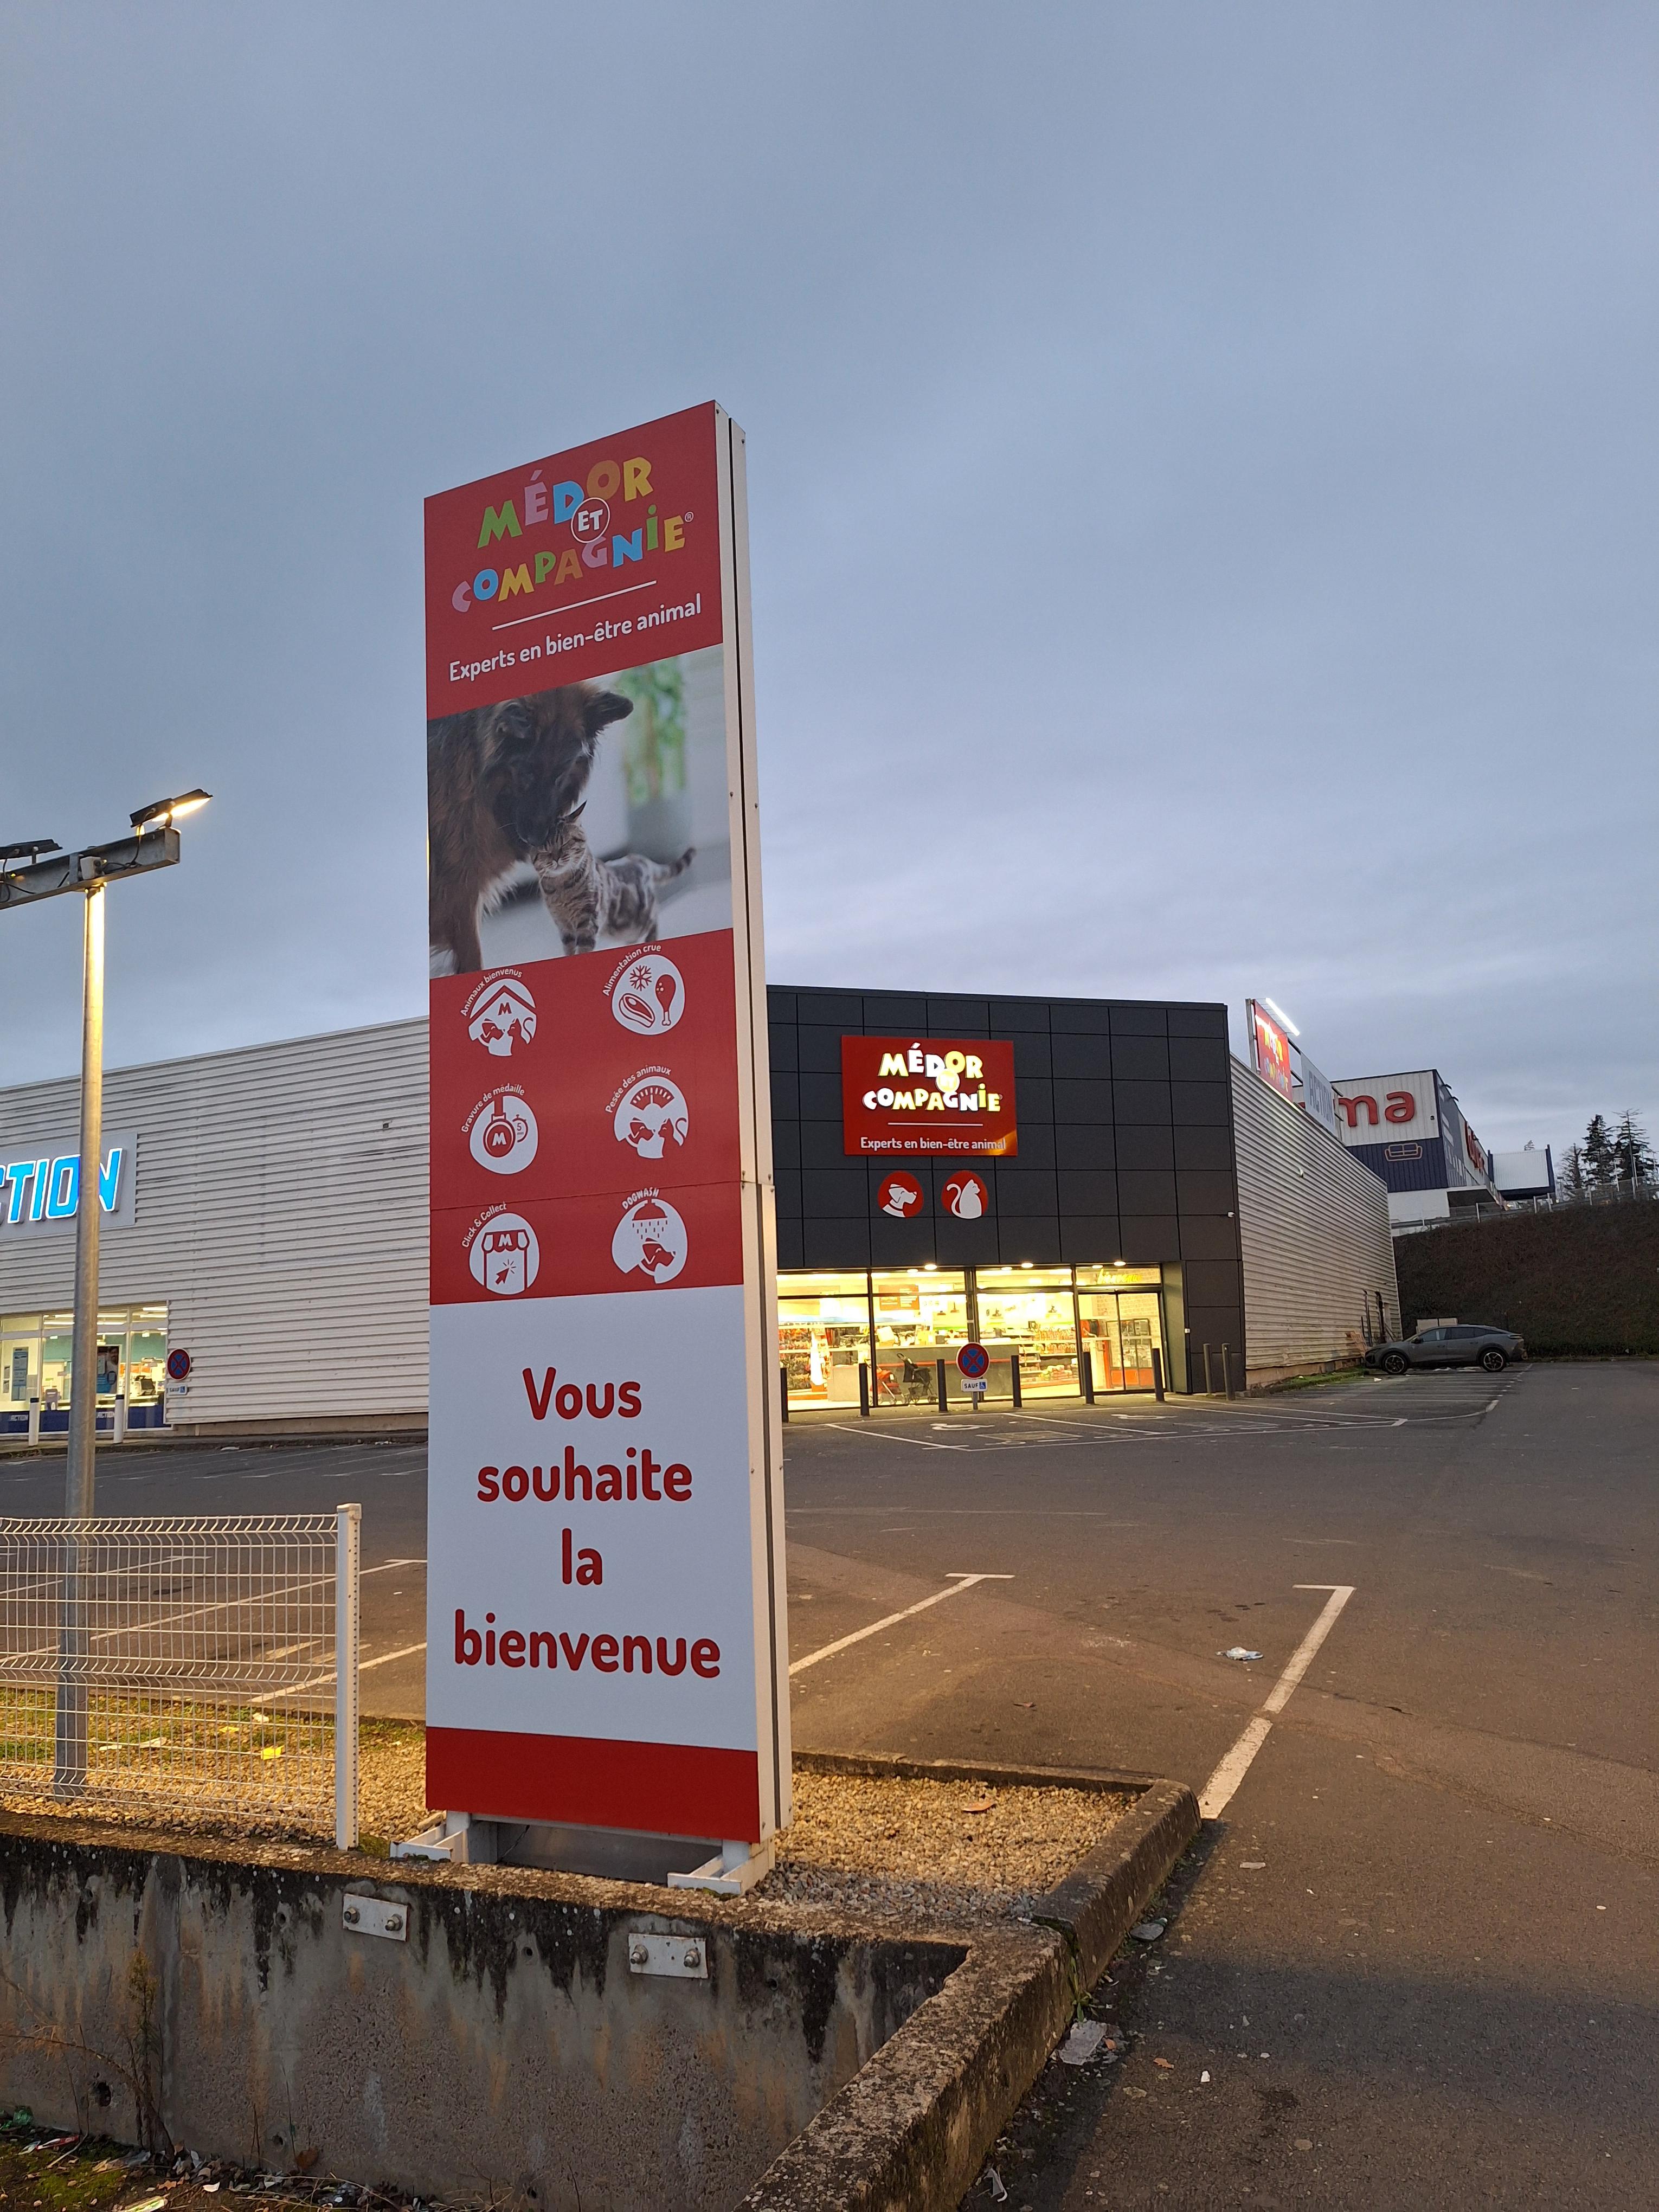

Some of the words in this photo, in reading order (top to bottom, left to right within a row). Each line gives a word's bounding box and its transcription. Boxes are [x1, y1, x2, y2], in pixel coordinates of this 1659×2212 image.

[477, 456, 653, 548] MÉDOR
[577, 509, 603, 532] ET
[449, 650, 516, 681] Experts
[520, 645, 541, 662] en
[546, 621, 633, 655] bien-être
[637, 593, 701, 630] animal
[460, 981, 485, 1016] Animaux
[484, 969, 523, 983] bienvenus
[602, 949, 642, 995] Alimentation
[498, 1002, 512, 1015] M
[877, 1043, 983, 1078] MÉDOR
[461, 1101, 483, 1132] Gravure
[483, 1093, 492, 1102] de
[493, 1083, 525, 1096] médaille
[605, 1088, 623, 1113] Pesée
[622, 1075, 636, 1088] des
[636, 1065, 671, 1077] animaux
[492, 1132, 506, 1146] M
[517, 1123, 522, 1131] 5
[860, 1137, 902, 1151] Experts
[920, 1137, 969, 1149] bien-être
[972, 1139, 1006, 1149] animal
[0, 1148, 123, 1223] TION
[622, 1187, 659, 1210] DOGWASH
[462, 1227, 477, 1247] Click
[474, 1219, 482, 1227] &
[480, 1201, 507, 1221] Collect
[498, 1233, 512, 1246] M
[522, 1367, 642, 1420] Vous
[477, 1445, 692, 1502] souhaite
[562, 1528, 603, 1585] la
[454, 1609, 721, 1678] bienvenue
